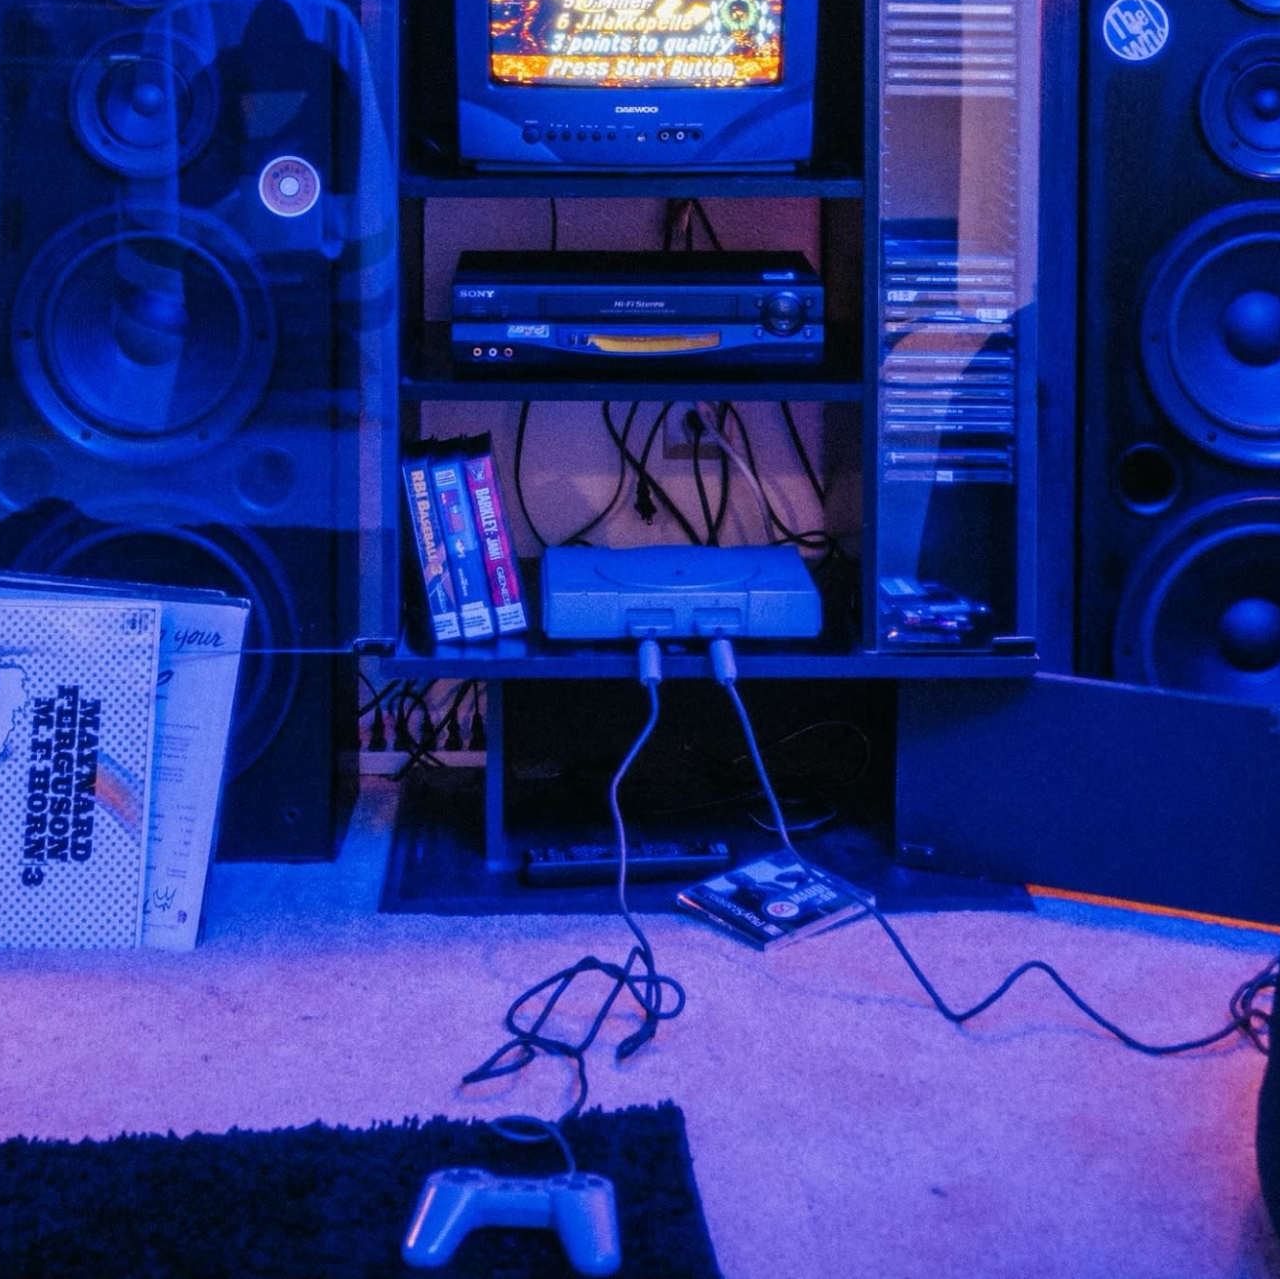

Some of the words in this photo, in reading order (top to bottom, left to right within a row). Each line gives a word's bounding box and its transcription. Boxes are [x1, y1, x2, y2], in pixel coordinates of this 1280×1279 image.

[551, 36, 564, 53] 3
[569, 35, 632, 55] points
[638, 35, 657, 53] to
[663, 34, 734, 55] qualify
[547, 59, 611, 78] Press
[616, 59, 666, 78] Start
[615, 105, 659, 114] DAEWOO
[458, 289, 495, 299] SONY
[410, 470, 428, 498] RBI
[46, 685, 80, 863] FERGUSON
[71, 699, 100, 862] MAYNARD
[24, 766, 51, 860] HORN
